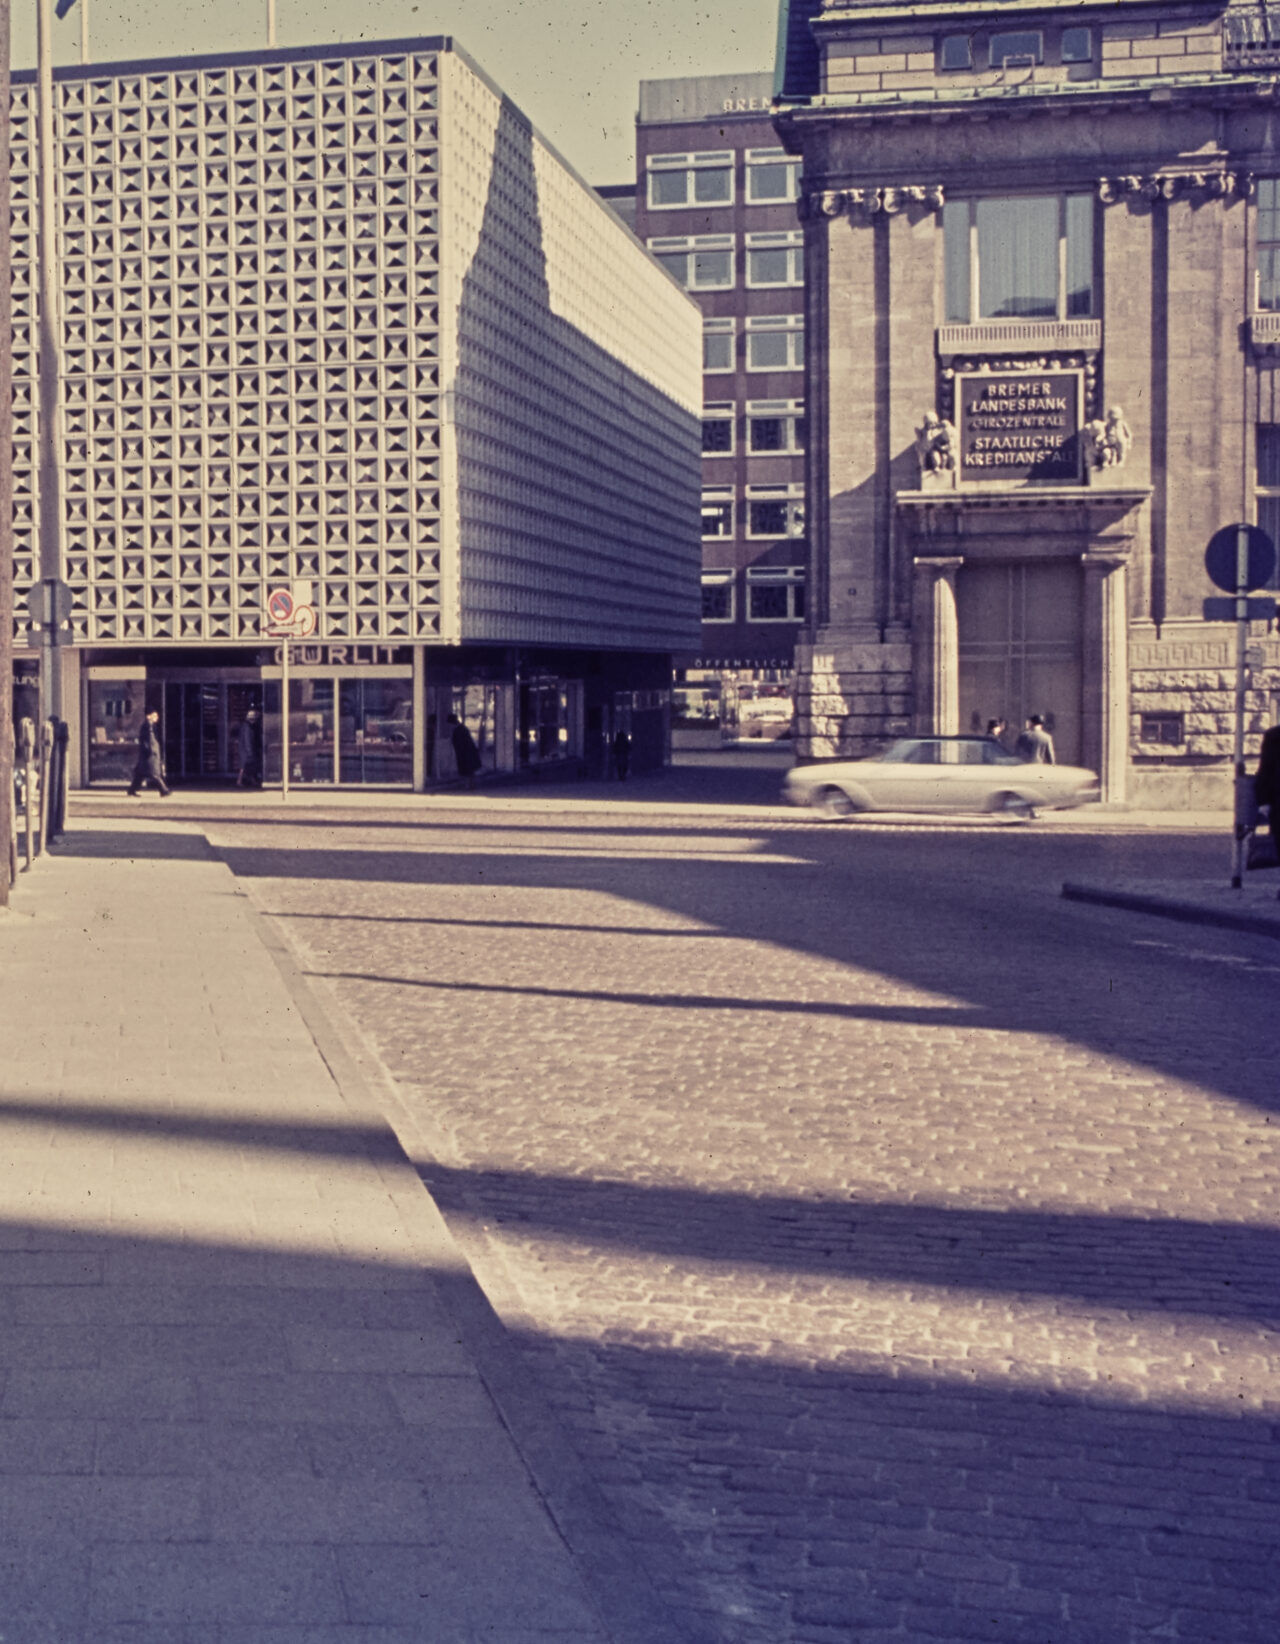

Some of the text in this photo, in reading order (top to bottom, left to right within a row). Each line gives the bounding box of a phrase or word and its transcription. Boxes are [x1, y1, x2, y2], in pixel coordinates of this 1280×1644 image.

[987, 382, 1051, 397] BREMER
[971, 397, 1067, 413] LANDESBANK
[972, 414, 1067, 429] GIROZENTRALE
[975, 435, 1064, 450] STAATLICHE
